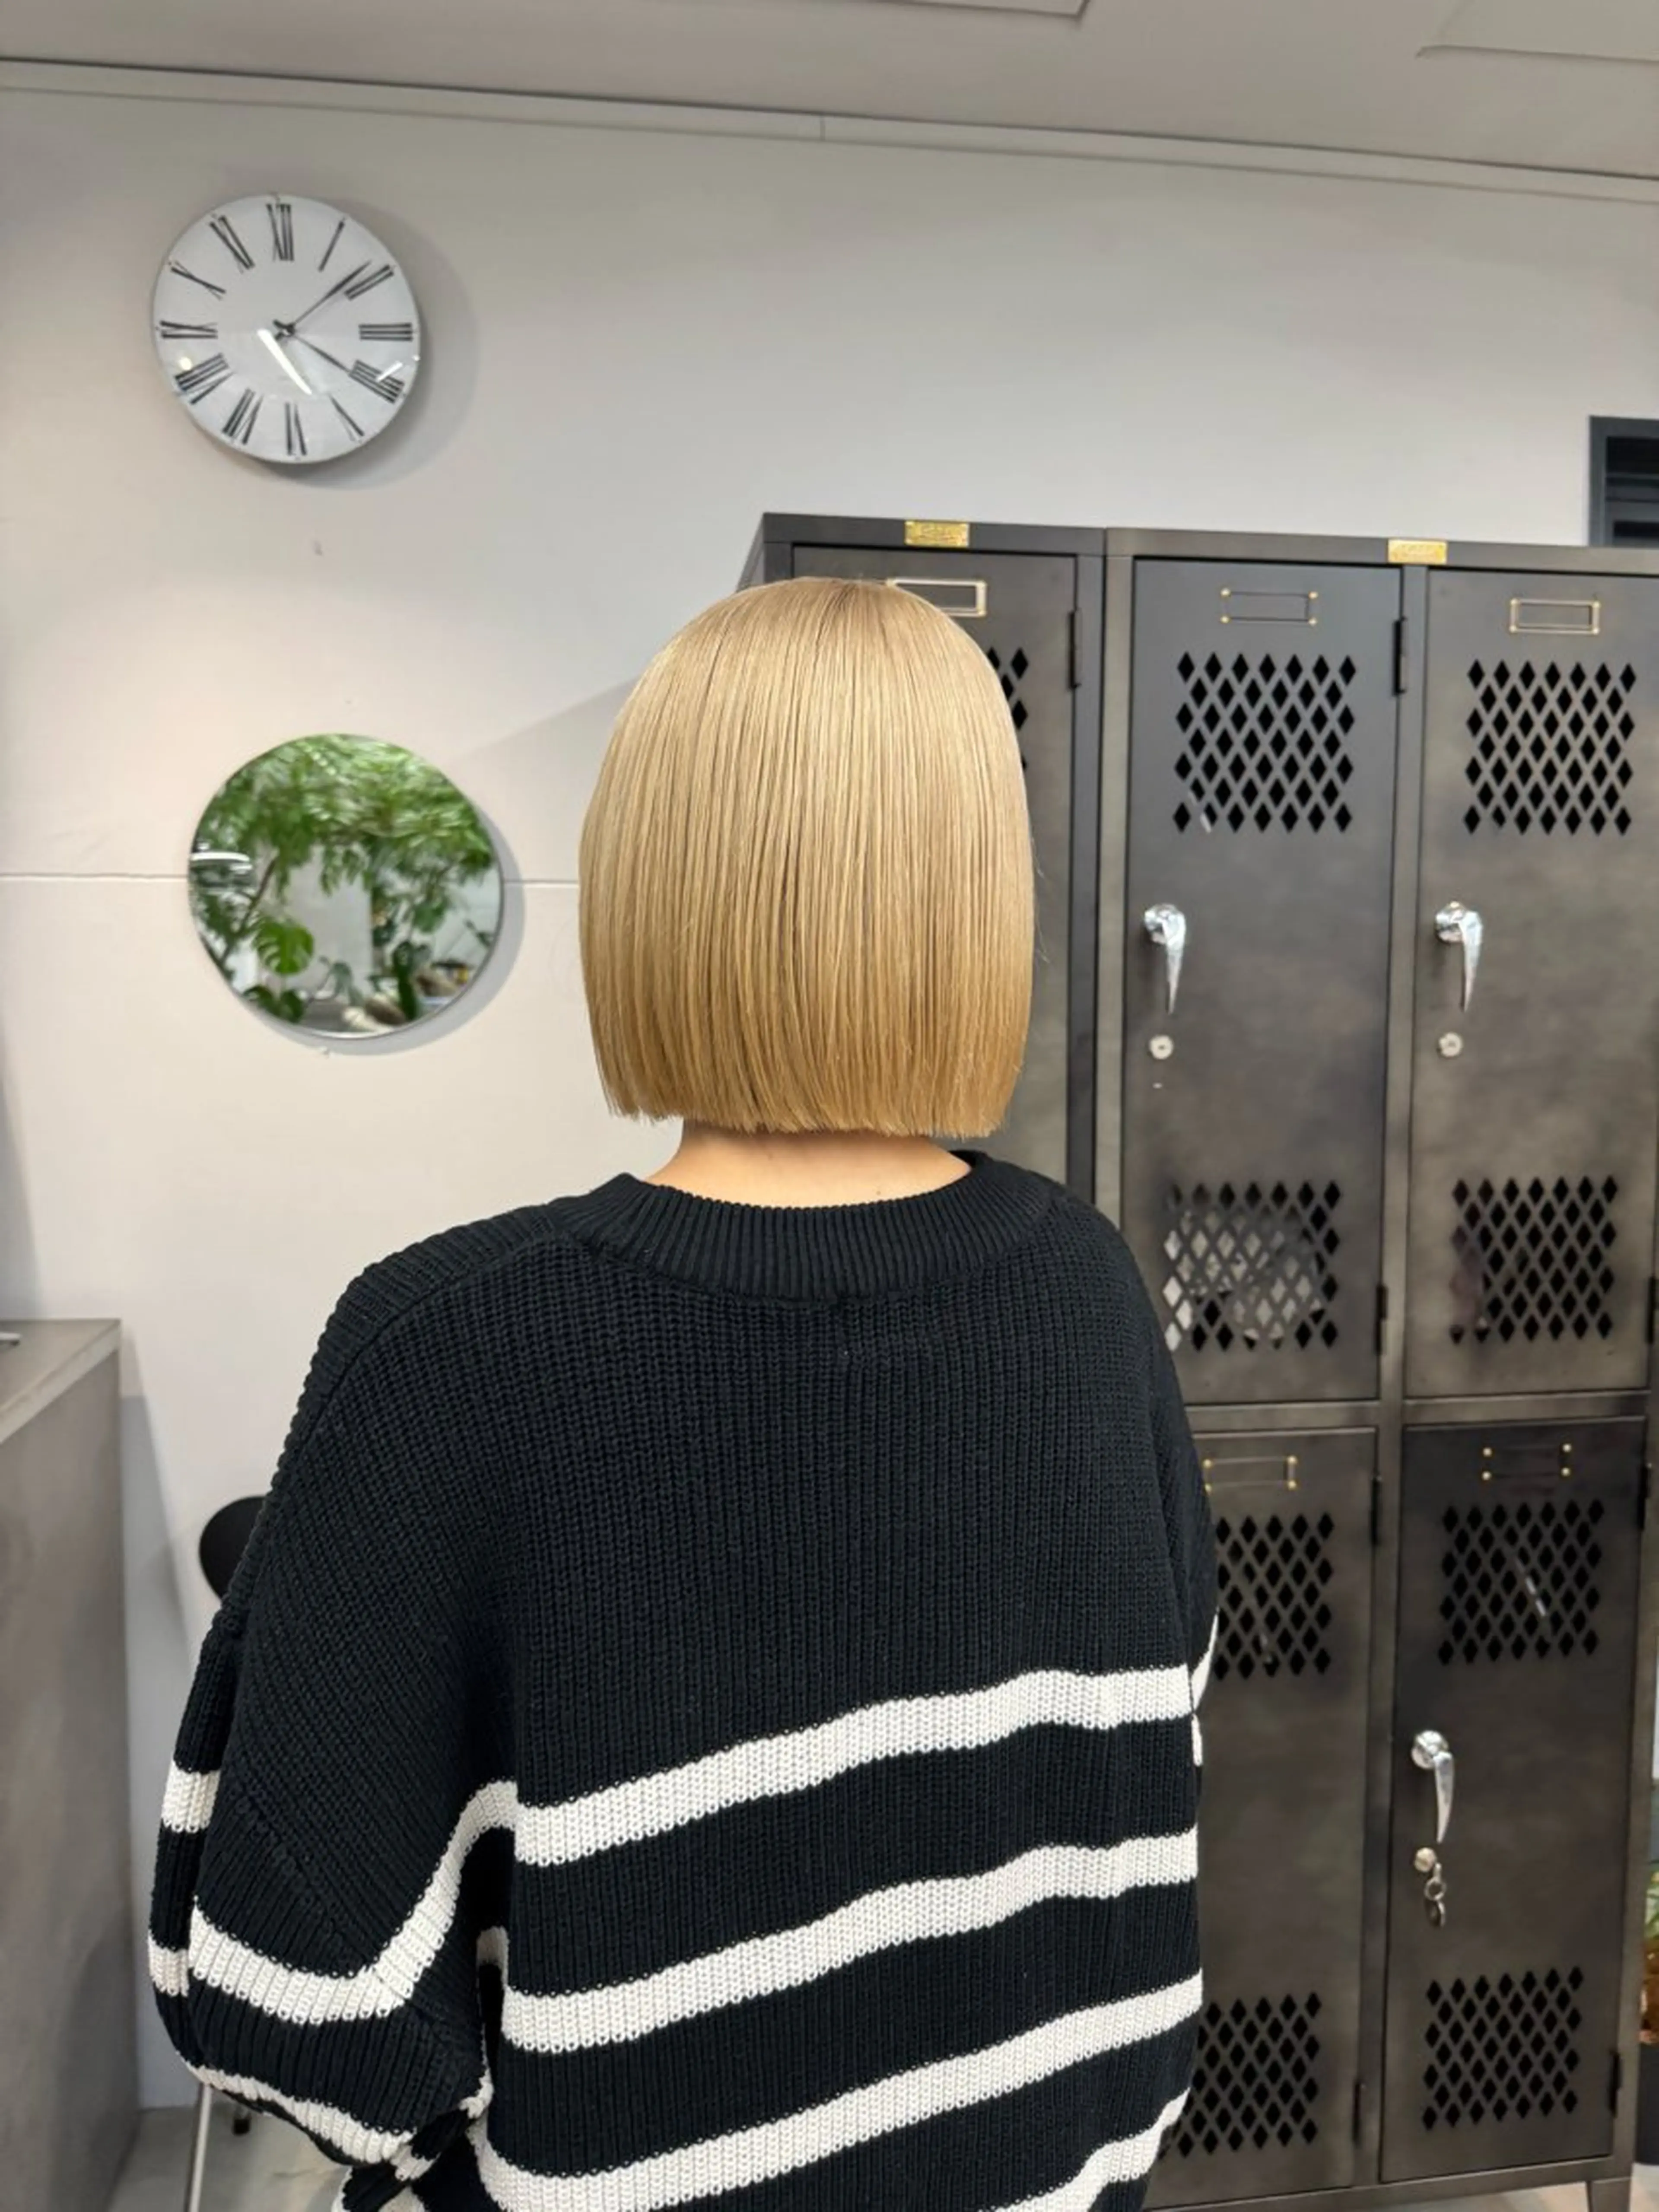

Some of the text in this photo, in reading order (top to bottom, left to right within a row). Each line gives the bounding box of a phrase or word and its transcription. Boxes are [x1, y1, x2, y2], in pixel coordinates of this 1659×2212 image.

[209, 216, 255, 273] XI
[265, 203, 295, 262] XII
[318, 221, 344, 272] I
[171, 260, 226, 300] X
[344, 264, 394, 301] II
[160, 320, 218, 339] IX
[359, 323, 413, 341] III
[174, 353, 237, 404] VIII
[222, 388, 264, 445] VII
[285, 402, 307, 456] VI
[327, 393, 364, 442] V
